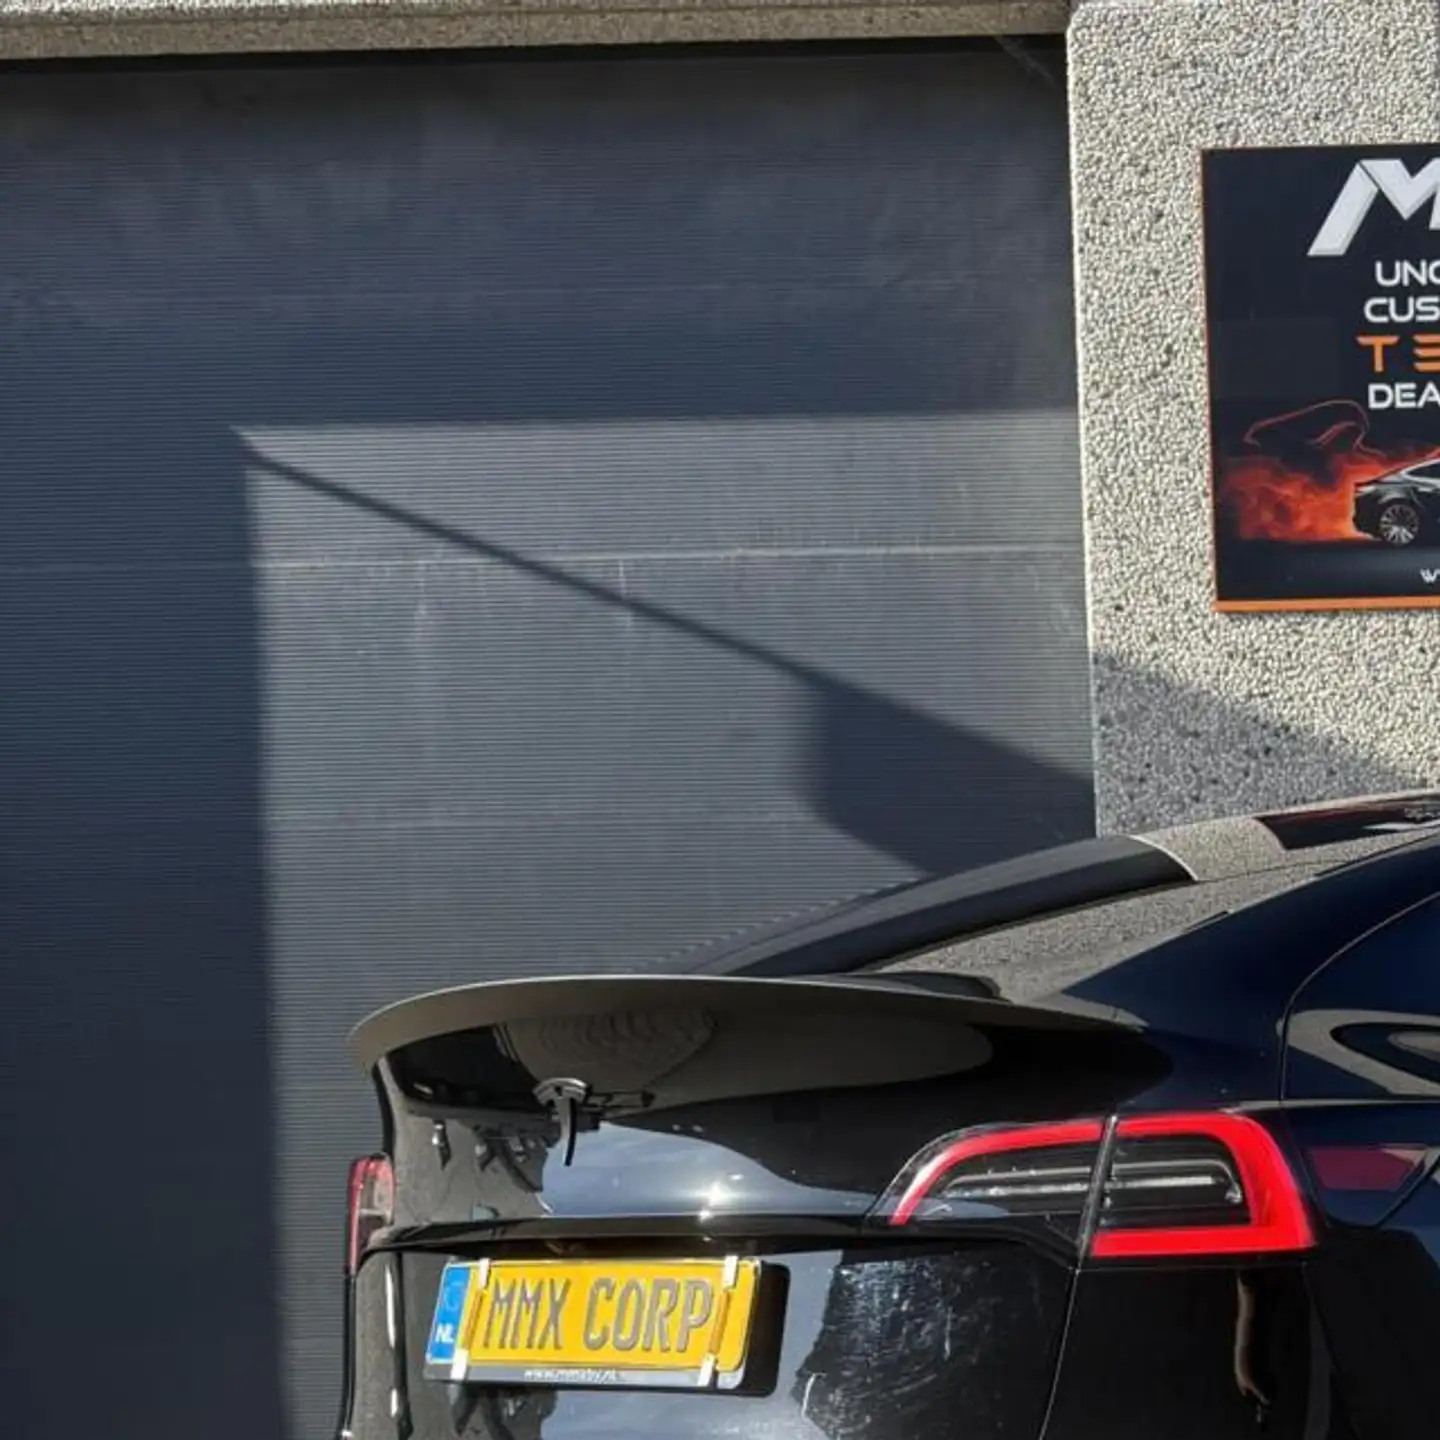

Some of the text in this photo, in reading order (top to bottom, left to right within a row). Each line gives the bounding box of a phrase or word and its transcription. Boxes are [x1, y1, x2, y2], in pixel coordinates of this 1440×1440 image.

[434, 1322, 455, 1344] NL
[482, 1277, 714, 1353] MMX CORP
